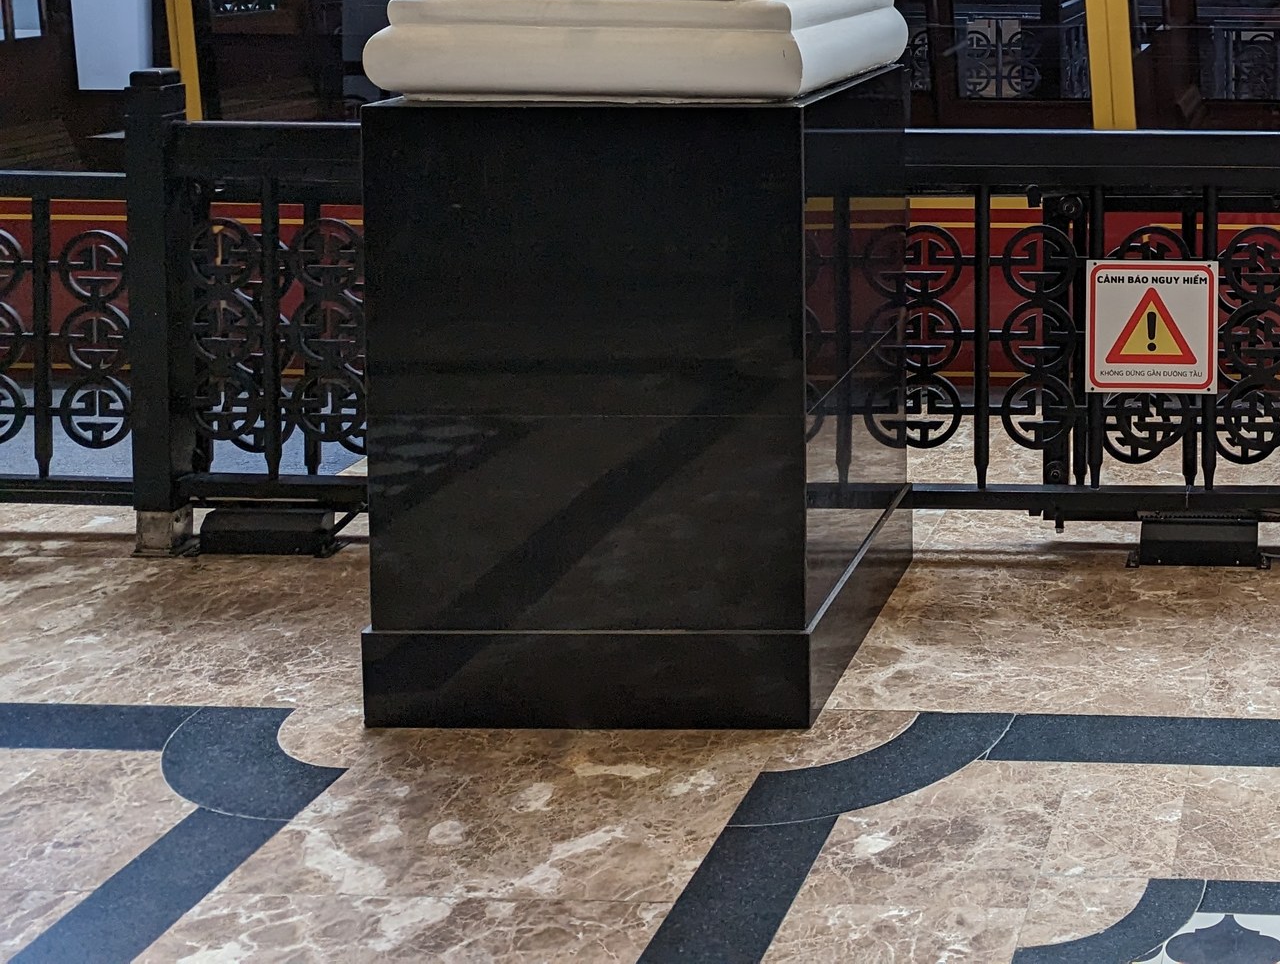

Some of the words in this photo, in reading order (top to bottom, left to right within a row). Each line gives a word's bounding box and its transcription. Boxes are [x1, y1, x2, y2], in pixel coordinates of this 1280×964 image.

[1097, 273, 1126, 285] CẢNH
[1127, 274, 1150, 285] BÁO
[1151, 276, 1181, 285] NGUY
[1099, 368, 1125, 377] KHÔNG
